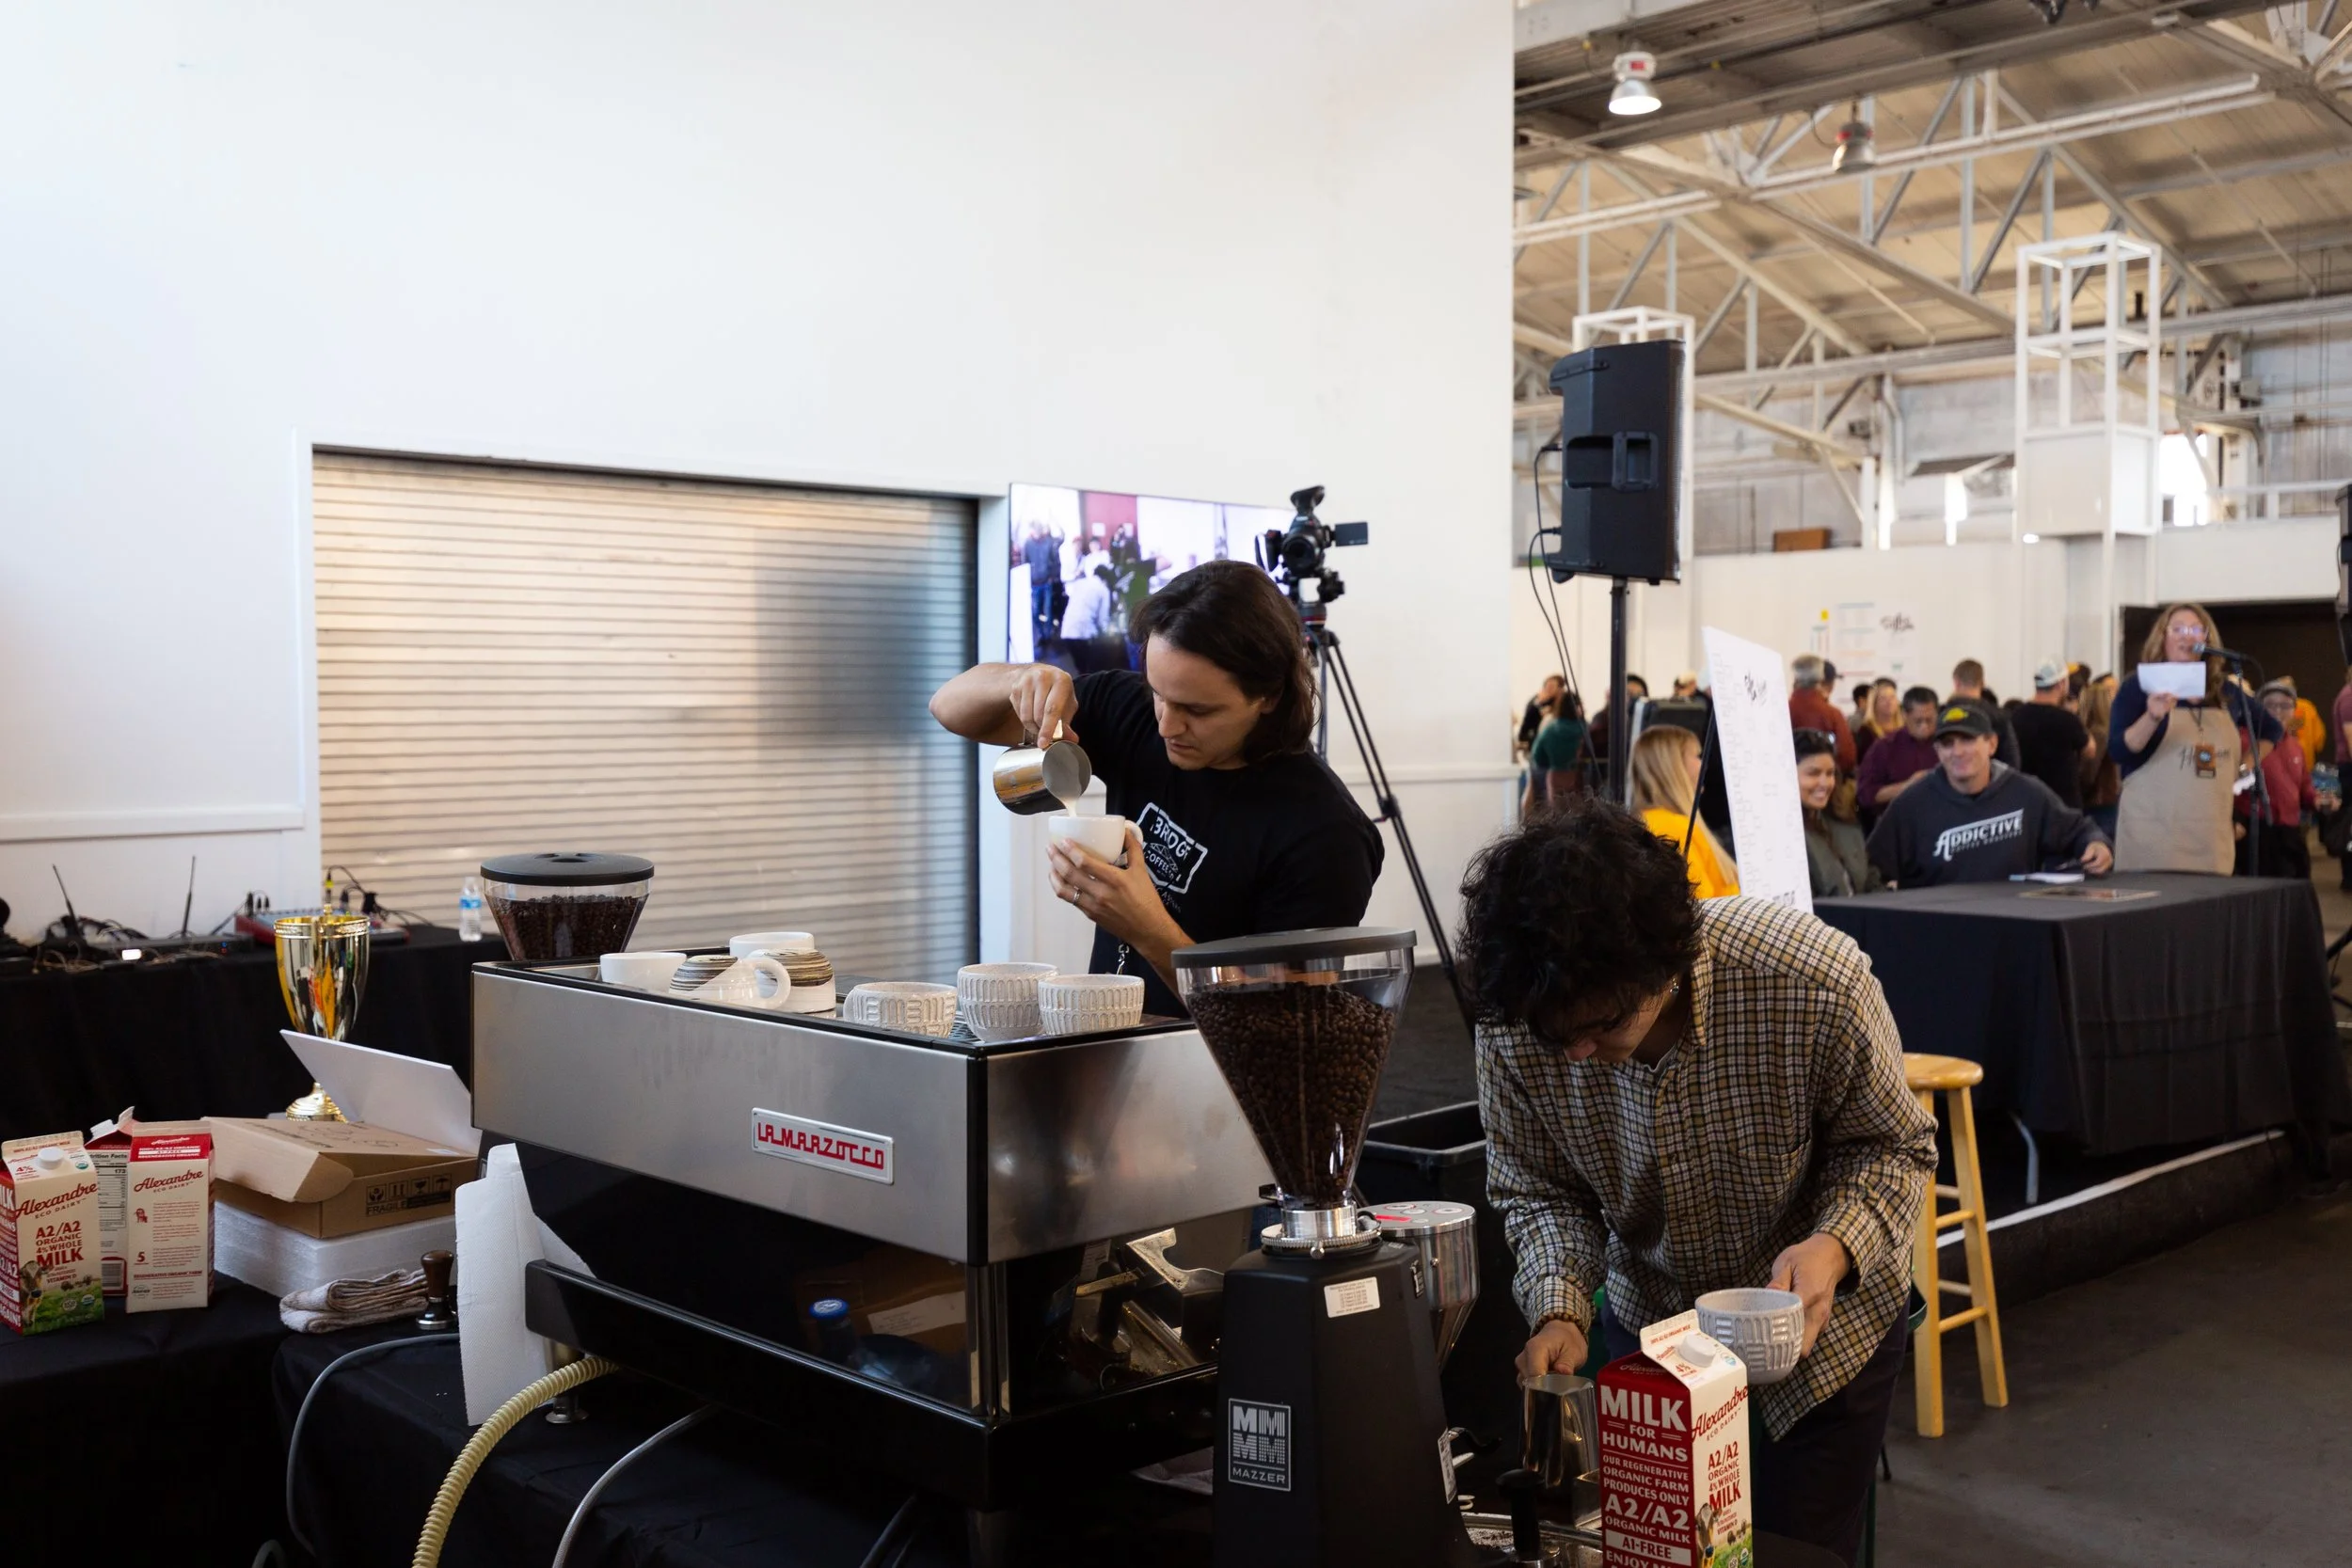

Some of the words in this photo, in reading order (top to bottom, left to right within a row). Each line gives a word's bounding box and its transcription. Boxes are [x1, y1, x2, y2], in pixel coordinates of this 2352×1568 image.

[1932, 808, 2024, 862] ADDICTIVE
[134, 1169, 204, 1193] Alexandre
[14, 1183, 98, 1219] Alexandre
[367, 1199, 408, 1215] FRAGILE
[35, 1210, 52, 1219] ECO
[36, 1221, 82, 1239] A2/A2
[36, 1232, 83, 1246] ORGANIC
[37, 1247, 85, 1269] MILK
[49, 1240, 84, 1253] WHOLE
[137, 1252, 146, 1262] 5
[1600, 1385, 1687, 1432] MILK
[1692, 1385, 1749, 1443] Alexandre
[1629, 1424, 1656, 1440] FOR
[1707, 1427, 1719, 1441] ECO
[1602, 1431, 1688, 1463] HUMANS
[1708, 1441, 1739, 1470] A2/A2
[1232, 1466, 1286, 1484] MAZZER
[1603, 1454, 1621, 1465] OUR
[1623, 1459, 1689, 1481] REGENERATIVE
[1603, 1465, 1652, 1485] ORGANIC
[1655, 1478, 1690, 1493] FARM
[1708, 1459, 1740, 1481] ORGANIC
[1718, 1468, 1740, 1488] WHOLE
[1603, 1478, 1658, 1500] PRODUCES
[1659, 1492, 1690, 1507] ONLY
[1708, 1479, 1741, 1512] MILK
[1605, 1493, 1691, 1531] A2/A2
[1605, 1515, 1657, 1537] ORGANIC
[1659, 1529, 1691, 1544] MILK
[1606, 1549, 1648, 1568] ENJOY
[1622, 1536, 1672, 1560] A1-FREE
